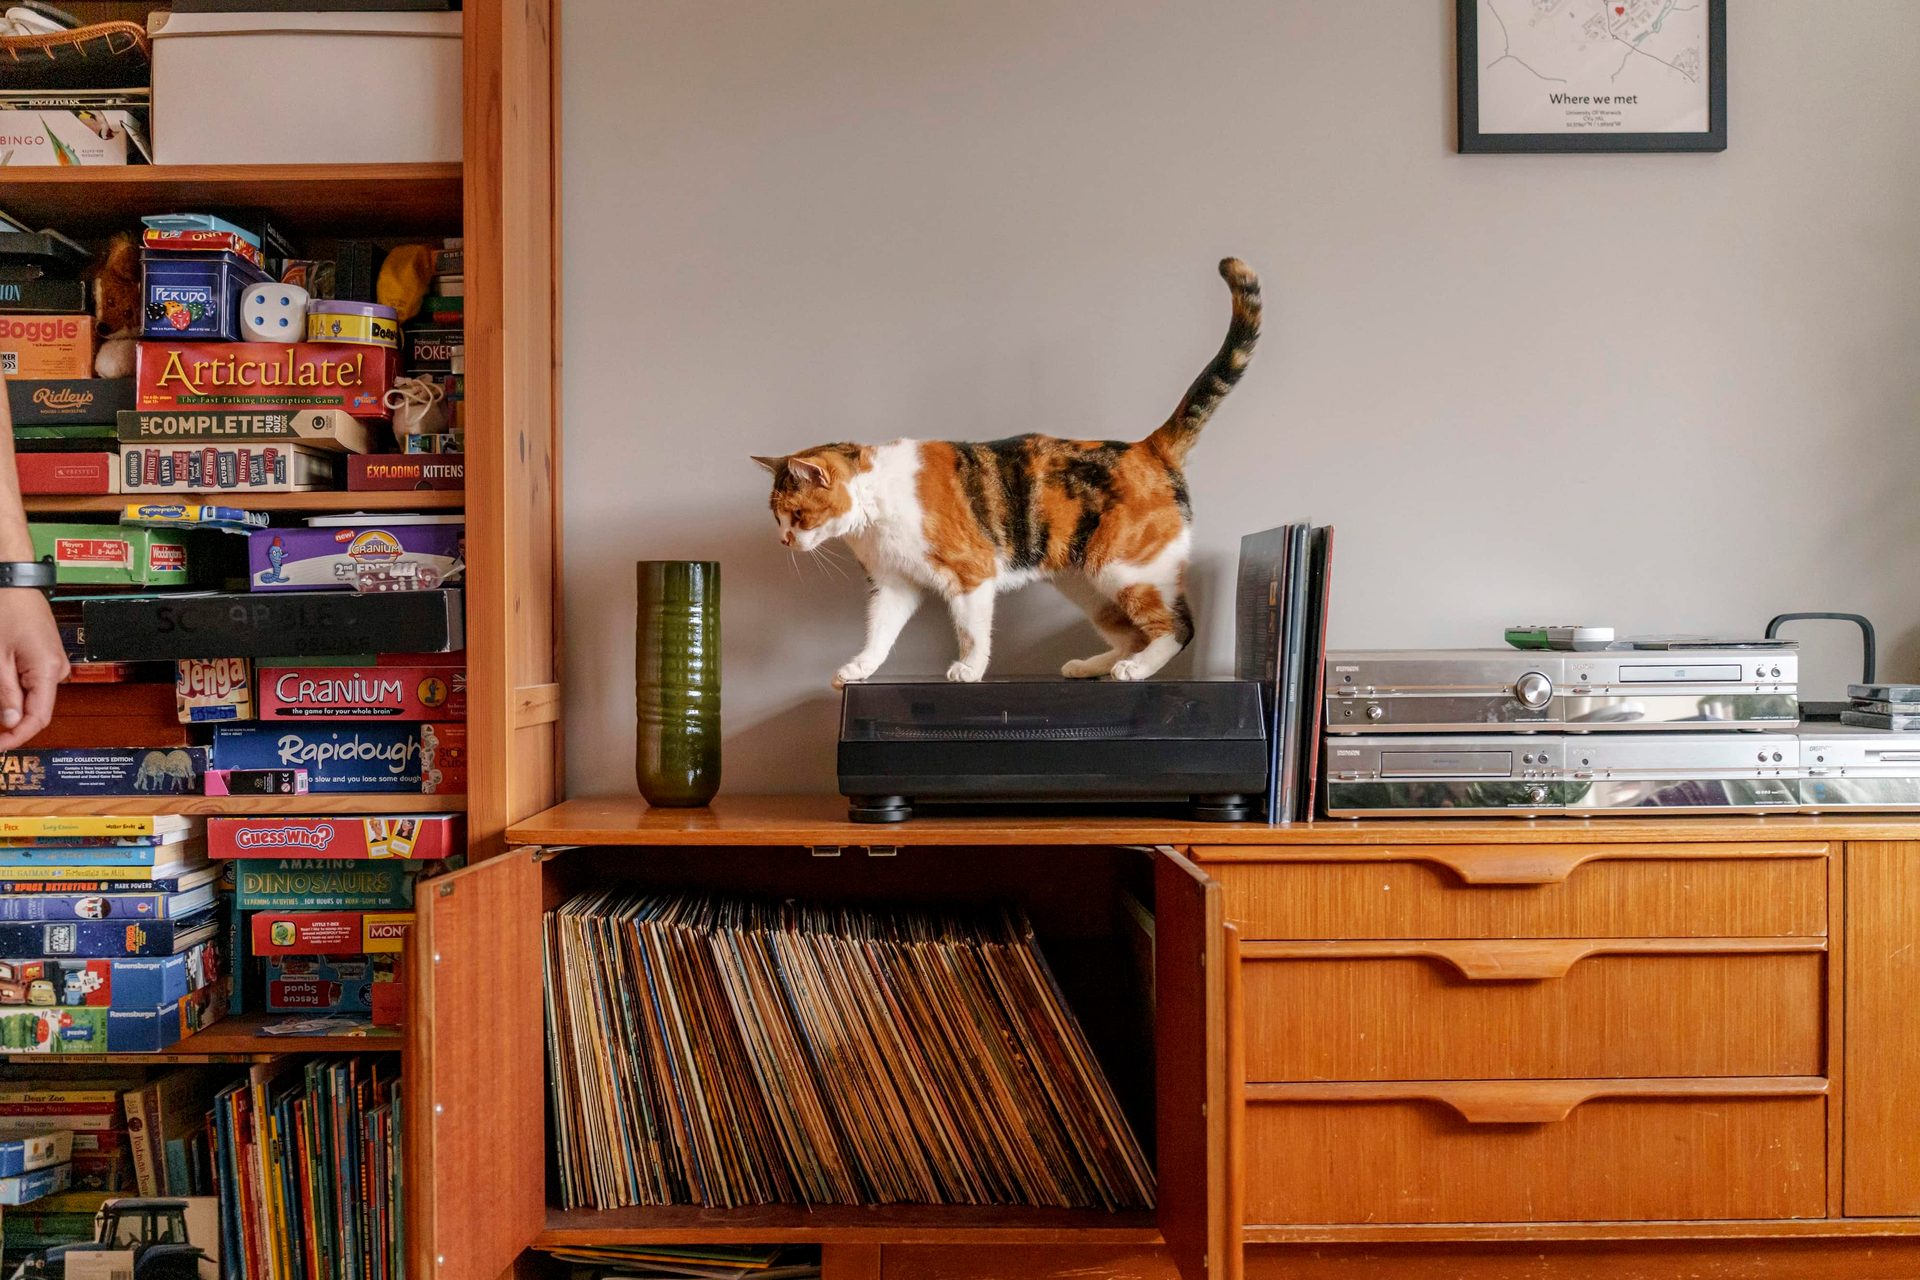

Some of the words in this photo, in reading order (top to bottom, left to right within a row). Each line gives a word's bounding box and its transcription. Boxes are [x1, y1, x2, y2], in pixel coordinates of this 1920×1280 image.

[1550, 93, 1590, 104] Where
[1614, 95, 1638, 104] met
[0, 136, 45, 145] BINGO
[156, 287, 207, 302] PERUDO
[0, 319, 78, 342] Boggle
[156, 348, 364, 396] Articulate!
[32, 388, 94, 409] Ridley's
[222, 396, 255, 405] Talking
[260, 396, 311, 405] Description
[315, 396, 340, 404] Game
[141, 416, 149, 435] THE
[150, 416, 265, 434] COMPLETE
[265, 415, 273, 433] PUB
[273, 415, 281, 433] QUIZ
[146, 457, 156, 480] BRITISH
[162, 459, 170, 482] ARTS
[206, 452, 214, 475] CENTURY
[250, 459, 260, 483] SPORT
[366, 465, 420, 479] EXPLODING
[423, 465, 464, 478] KITTENS
[335, 531, 355, 541] new!
[335, 564, 353, 576] 2nd
[179, 658, 245, 697] Jenga
[304, 708, 323, 716] game
[277, 732, 422, 774] Rapidough
[347, 777, 361, 785] you
[399, 776, 421, 785] dough
[238, 831, 286, 846] Guess
[286, 826, 331, 850] Who?
[279, 859, 356, 869] AMAZING
[244, 872, 393, 894] DINOSAURS
[114, 962, 161, 971] Ravensburger
[284, 983, 318, 993] Squad
[283, 995, 319, 1005] Rescue
[110, 1010, 157, 1019] Ravensburger
[24, 1094, 46, 1102] Dear
[48, 1094, 65, 1102] Zoo
[132, 1135, 146, 1173] Postman
[140, 1174, 150, 1196] Bear
